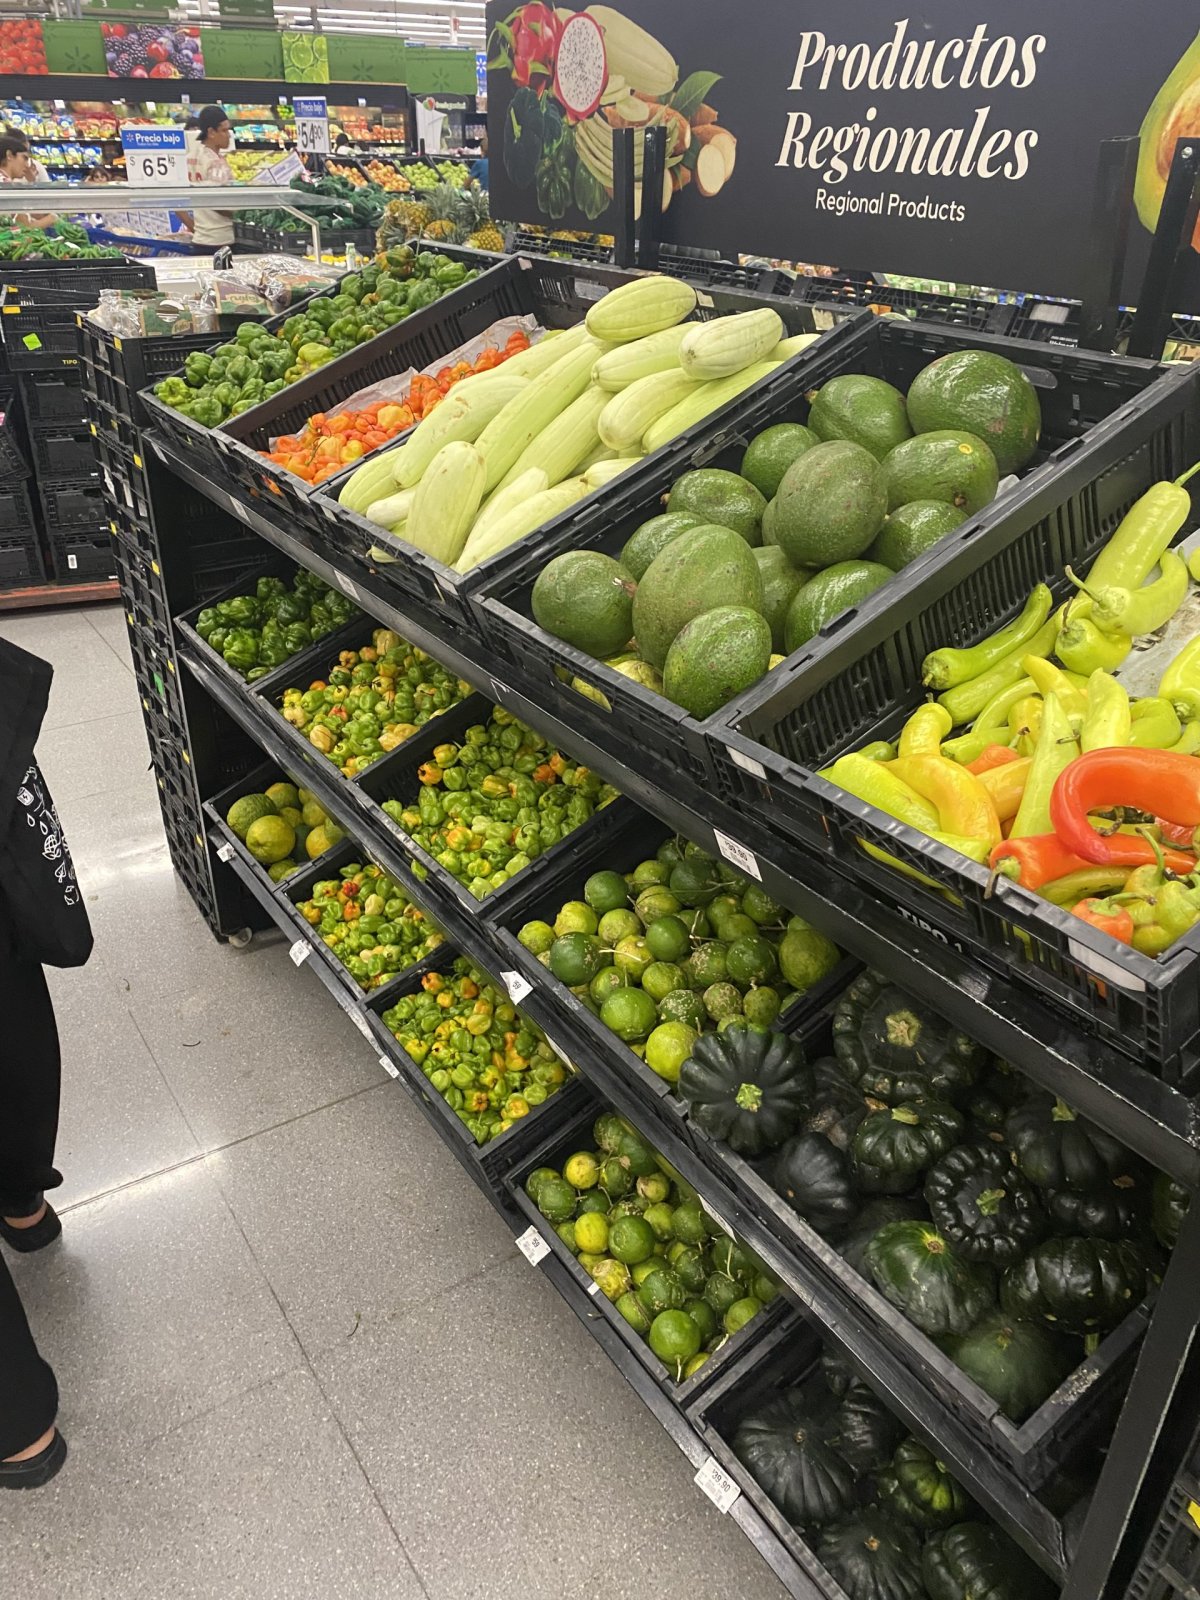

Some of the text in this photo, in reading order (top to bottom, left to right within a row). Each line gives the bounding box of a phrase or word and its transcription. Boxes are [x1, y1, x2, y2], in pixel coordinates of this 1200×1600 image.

[786, 18, 1047, 91] Productos
[135, 132, 162, 143] Precio
[162, 133, 181, 145] bajo
[774, 105, 1039, 184] Regionales
[143, 157, 168, 177] 65
[815, 188, 966, 222] Regional Products
